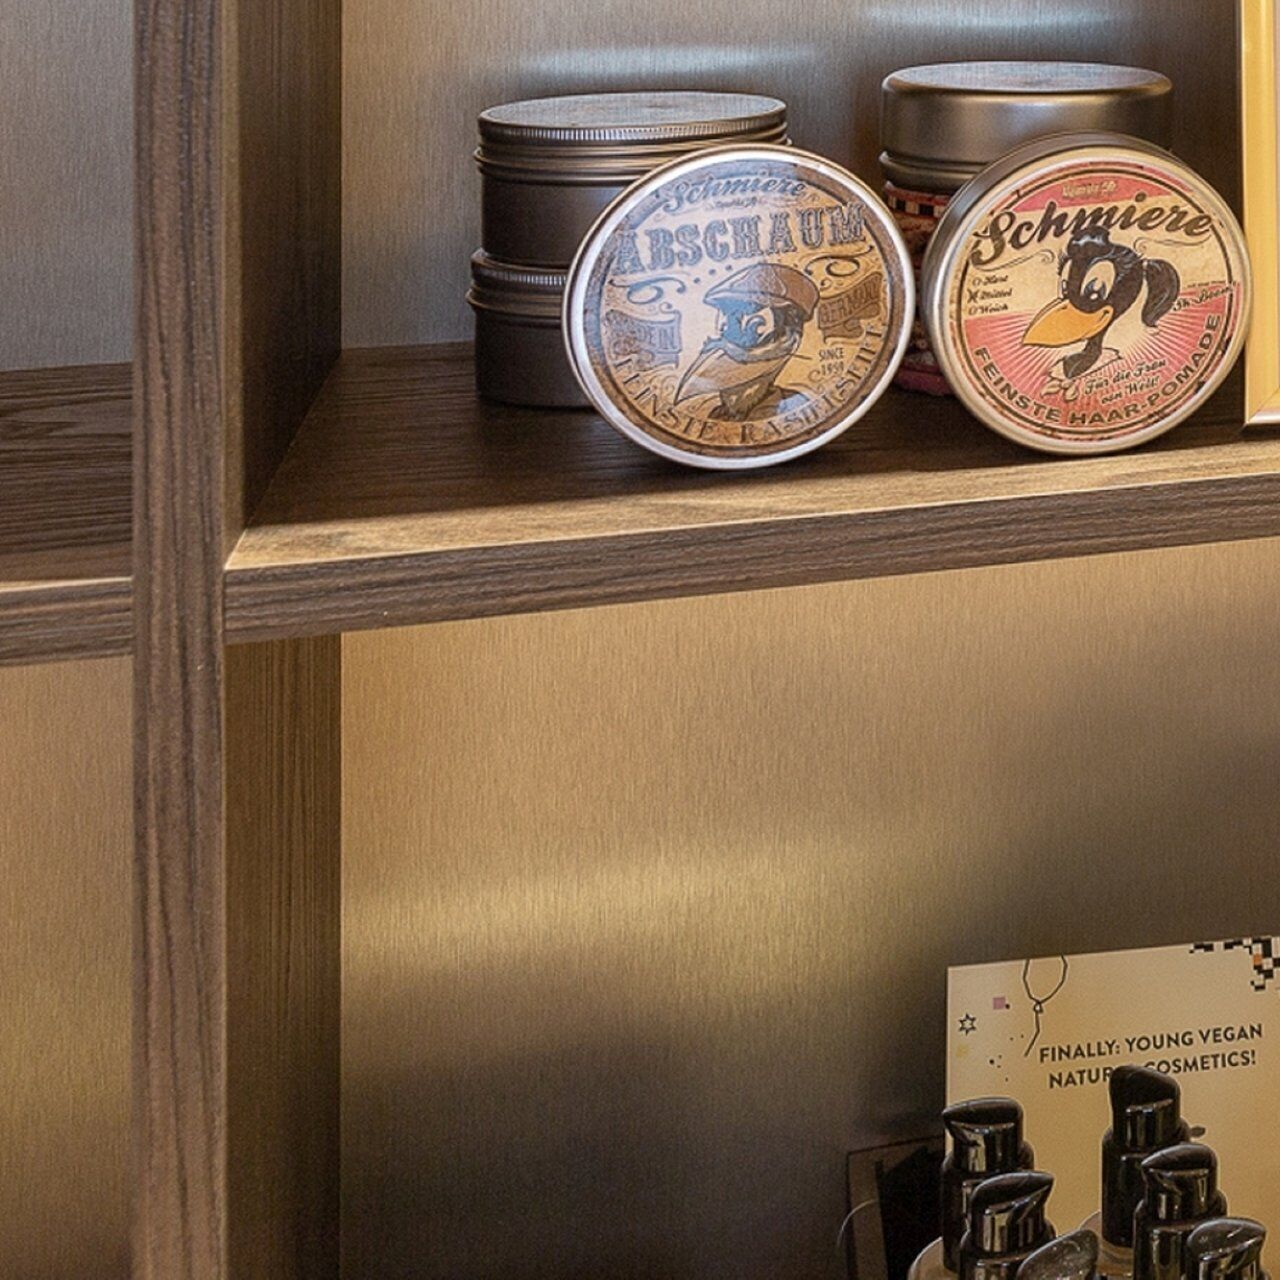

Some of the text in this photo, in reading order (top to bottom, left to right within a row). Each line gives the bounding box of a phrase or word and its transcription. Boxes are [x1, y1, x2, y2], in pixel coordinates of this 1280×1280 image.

[663, 174, 807, 213] Schmiere
[614, 203, 869, 275] ABSCHAUM
[967, 192, 1214, 266] Schmiere
[973, 314, 1222, 425] FEINSTE HAAR-POMADE
[1039, 1023, 1264, 1064] FINALLY: YOUNG VEGAN
[1048, 1067, 1112, 1090] NATUR
